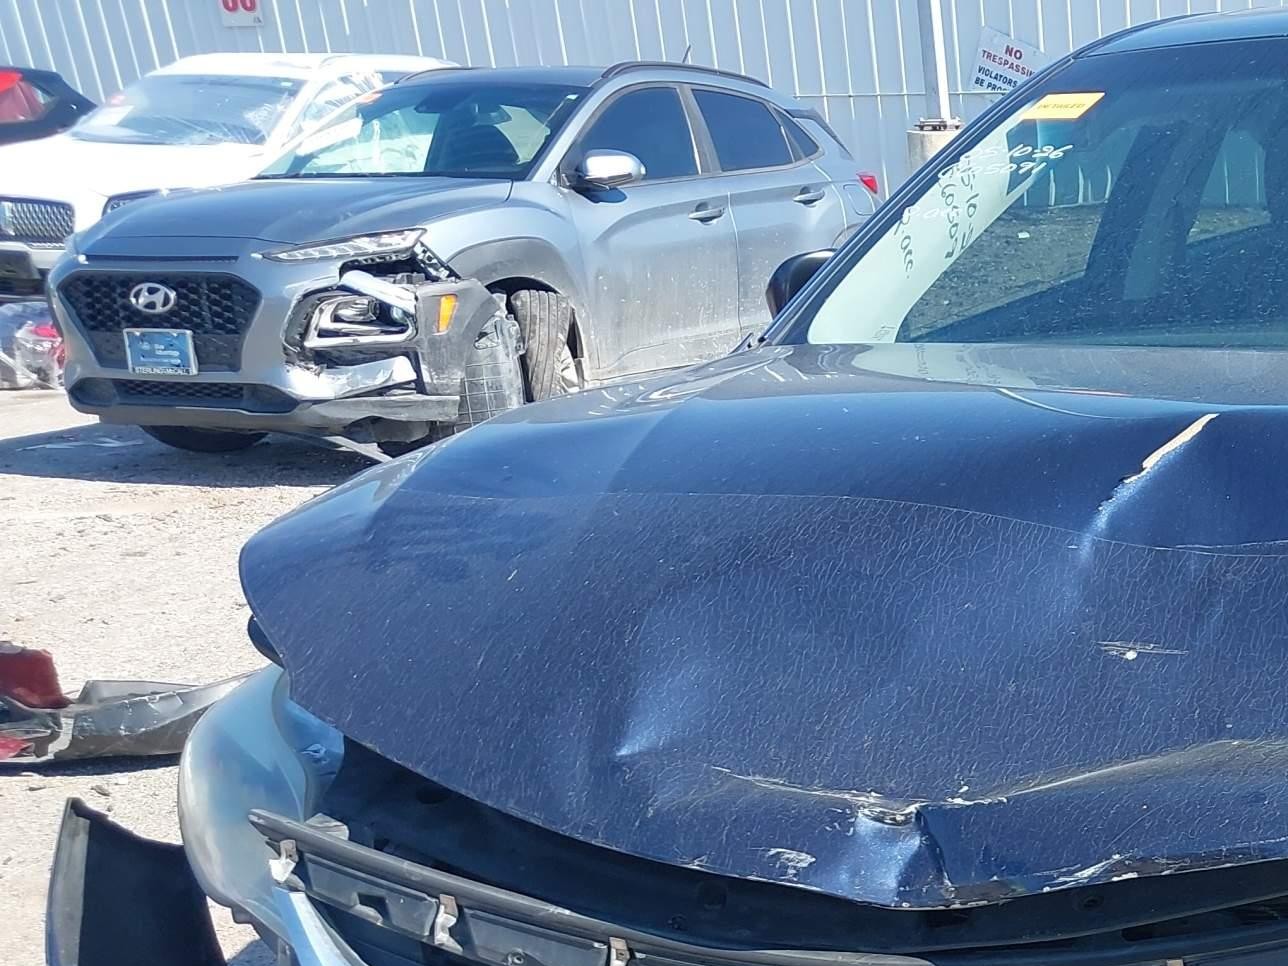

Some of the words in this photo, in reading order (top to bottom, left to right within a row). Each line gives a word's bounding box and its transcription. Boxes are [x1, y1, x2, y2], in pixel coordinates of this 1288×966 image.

[1004, 44, 1023, 61] NO
[974, 76, 985, 88] BE
[977, 65, 1018, 89] VIOLATORS
